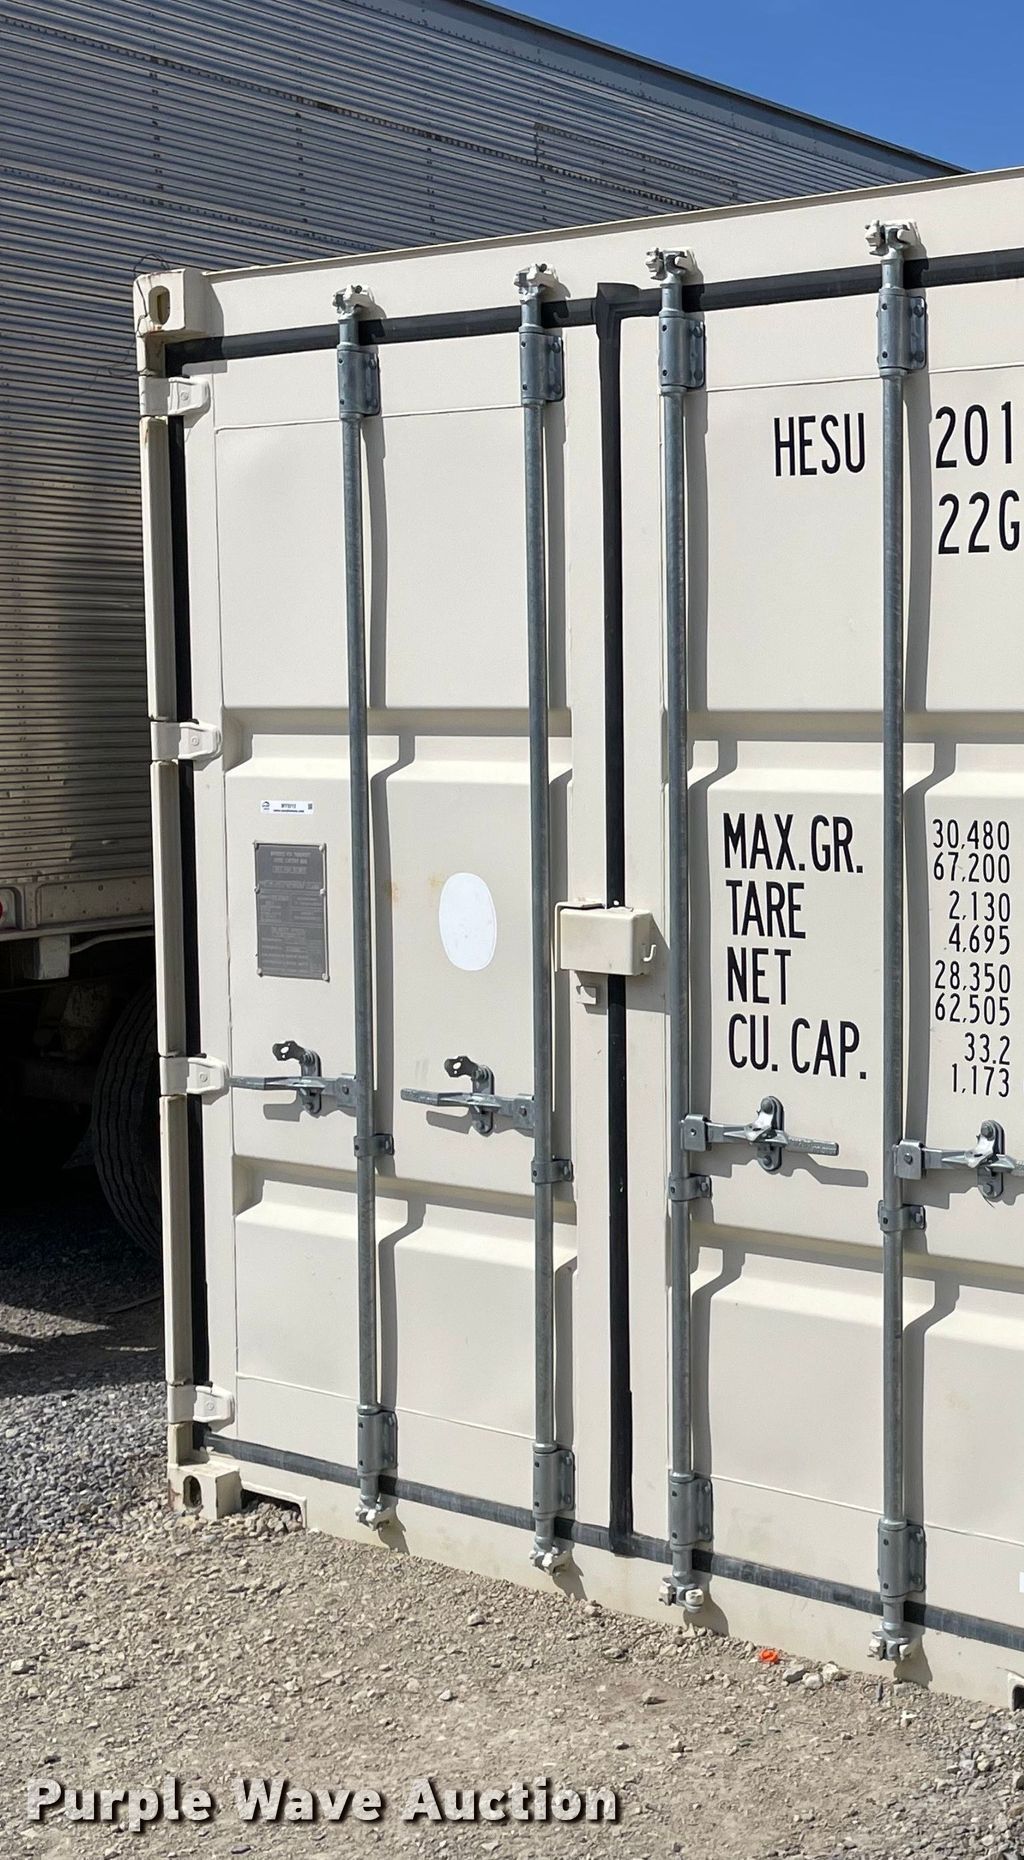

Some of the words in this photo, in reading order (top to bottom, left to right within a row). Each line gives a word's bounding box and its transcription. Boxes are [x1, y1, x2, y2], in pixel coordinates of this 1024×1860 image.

[774, 413, 865, 476] HESU
[933, 819, 1009, 850] 30,480
[934, 852, 1009, 883] 67,200
[726, 880, 805, 939] TARE
[950, 890, 1010, 922] 2,130
[949, 923, 1009, 954] 4,695
[728, 947, 791, 1004] NET
[935, 960, 1010, 994] 28,350
[936, 991, 1009, 1026] 62,505
[965, 1033, 1009, 1065] 33.2
[952, 1062, 1009, 1097] 1,173
